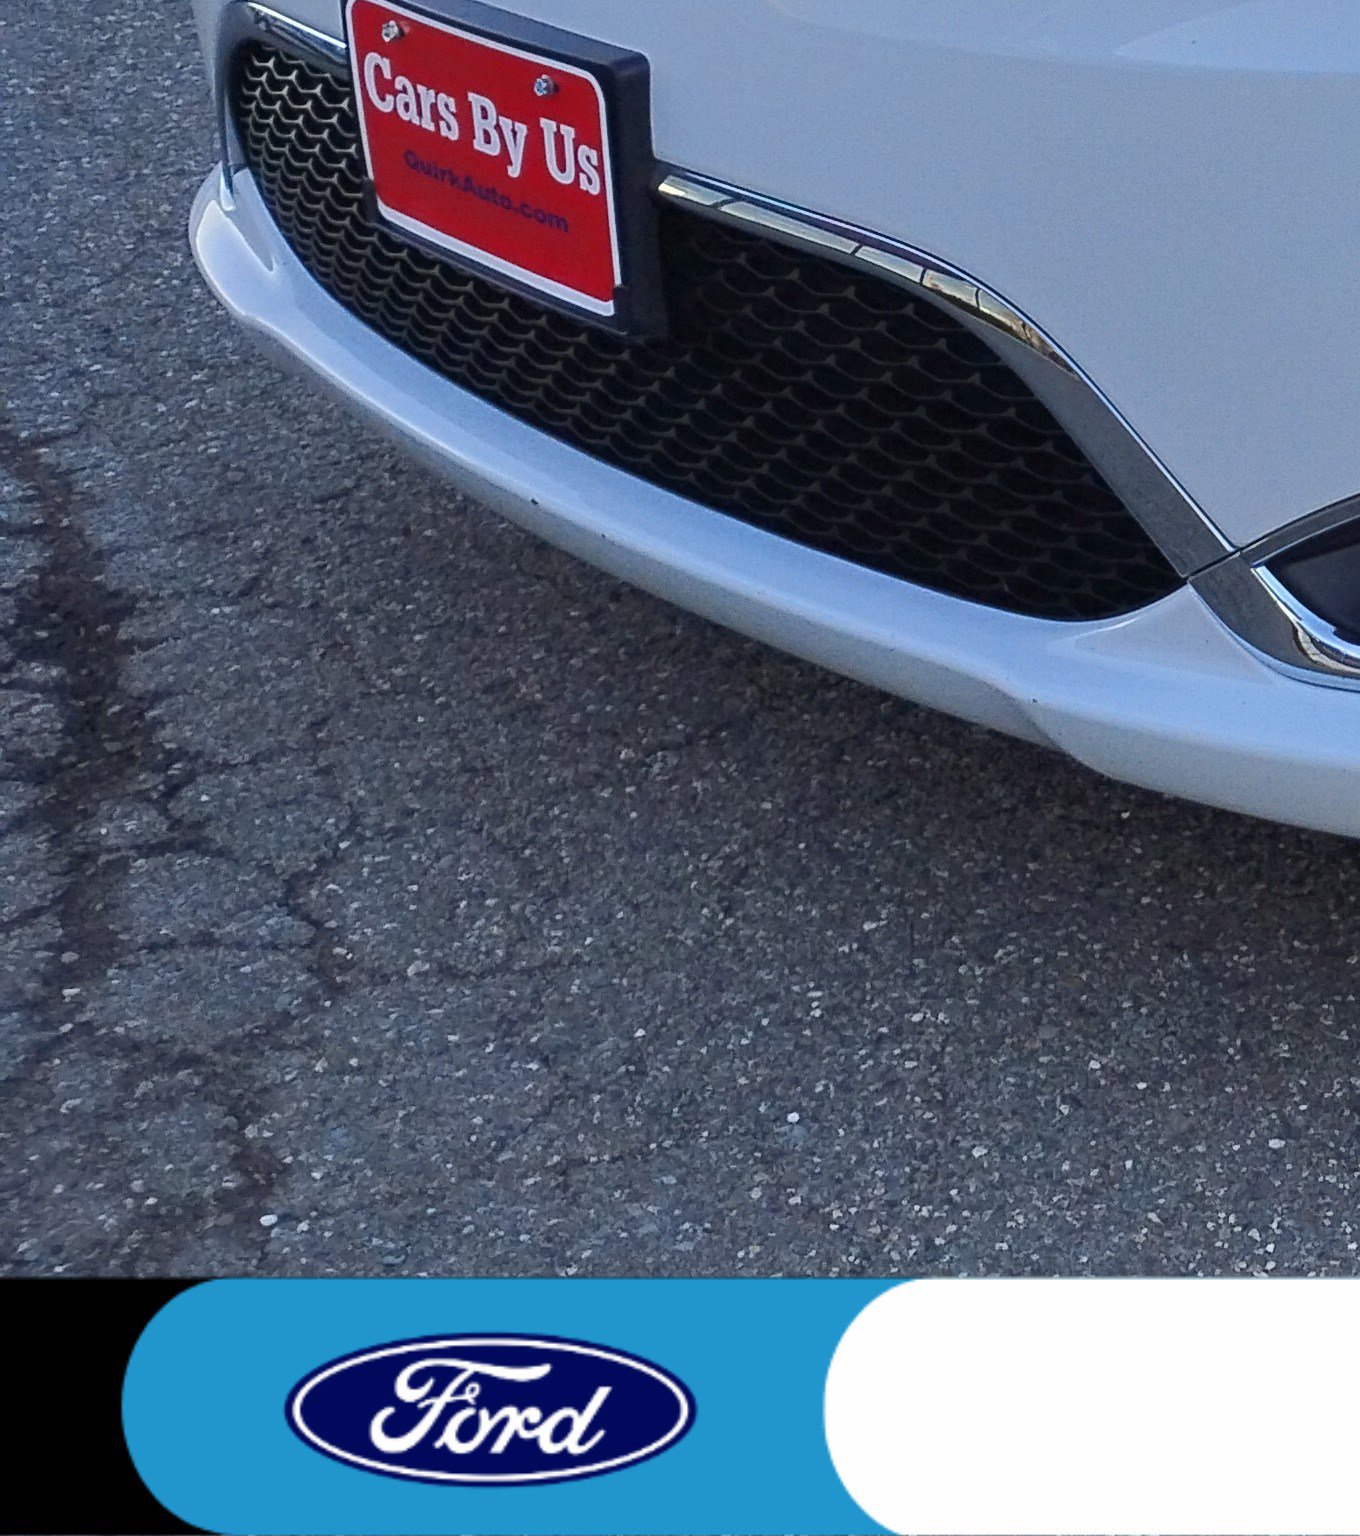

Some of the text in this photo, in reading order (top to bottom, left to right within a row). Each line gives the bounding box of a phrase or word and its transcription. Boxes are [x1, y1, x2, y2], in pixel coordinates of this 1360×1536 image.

[363, 51, 602, 196] Cars By Us
[403, 148, 570, 234] QuirkAuto.com
